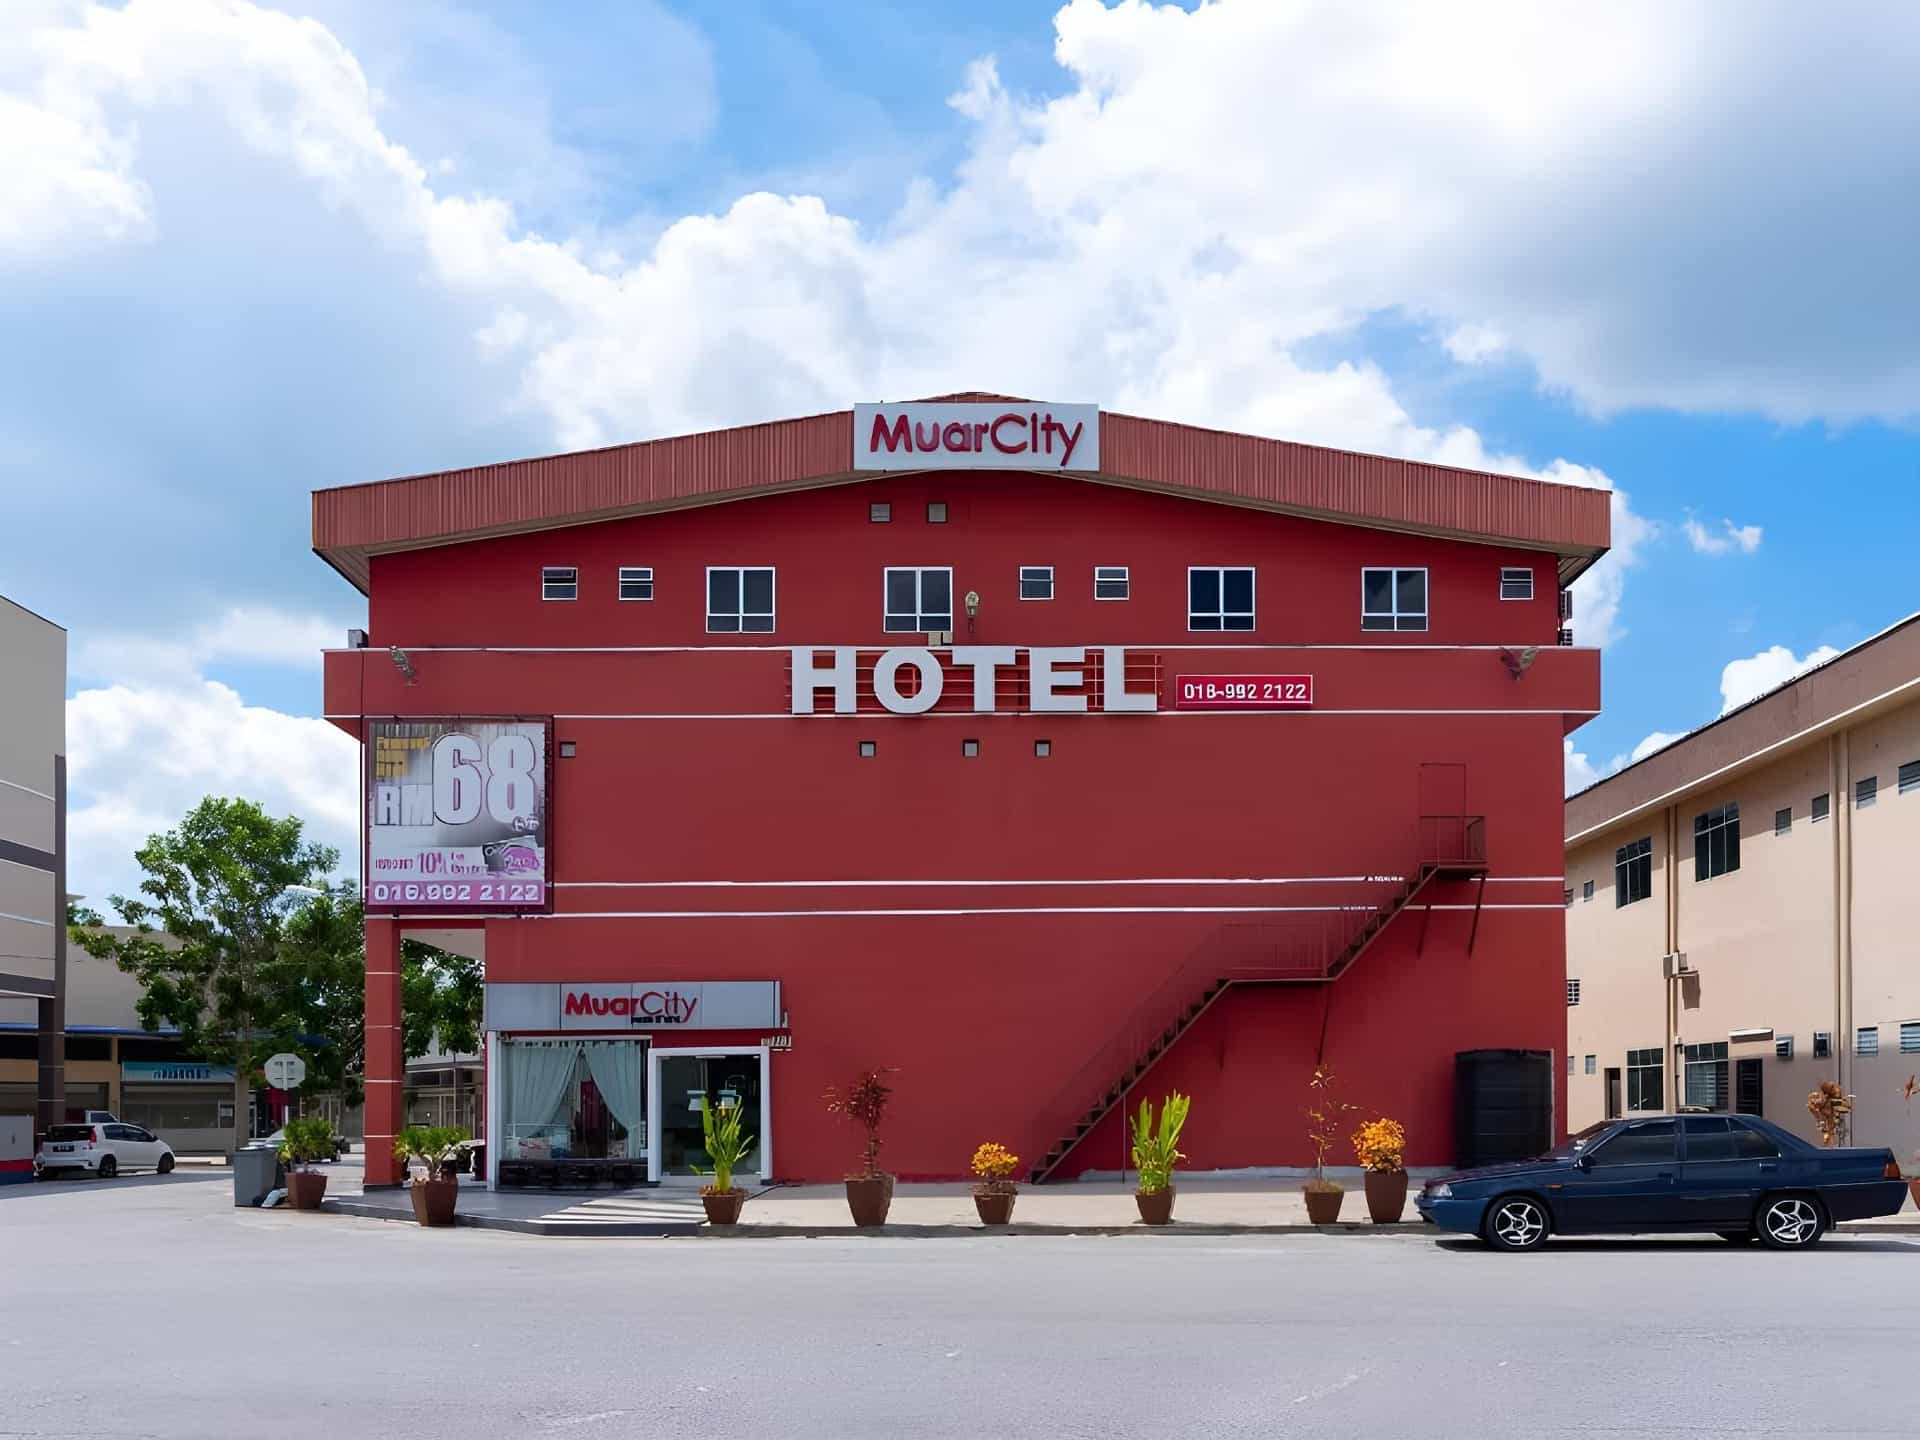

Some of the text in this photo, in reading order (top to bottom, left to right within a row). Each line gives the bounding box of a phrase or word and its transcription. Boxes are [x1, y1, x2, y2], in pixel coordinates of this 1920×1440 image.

[870, 412, 1083, 467] MuarCity
[791, 646, 1158, 714] HOTEL
[1263, 683, 1307, 699] 2122
[432, 732, 536, 826] 68
[479, 884, 540, 901] 2122
[565, 991, 697, 1023] MuarCity
